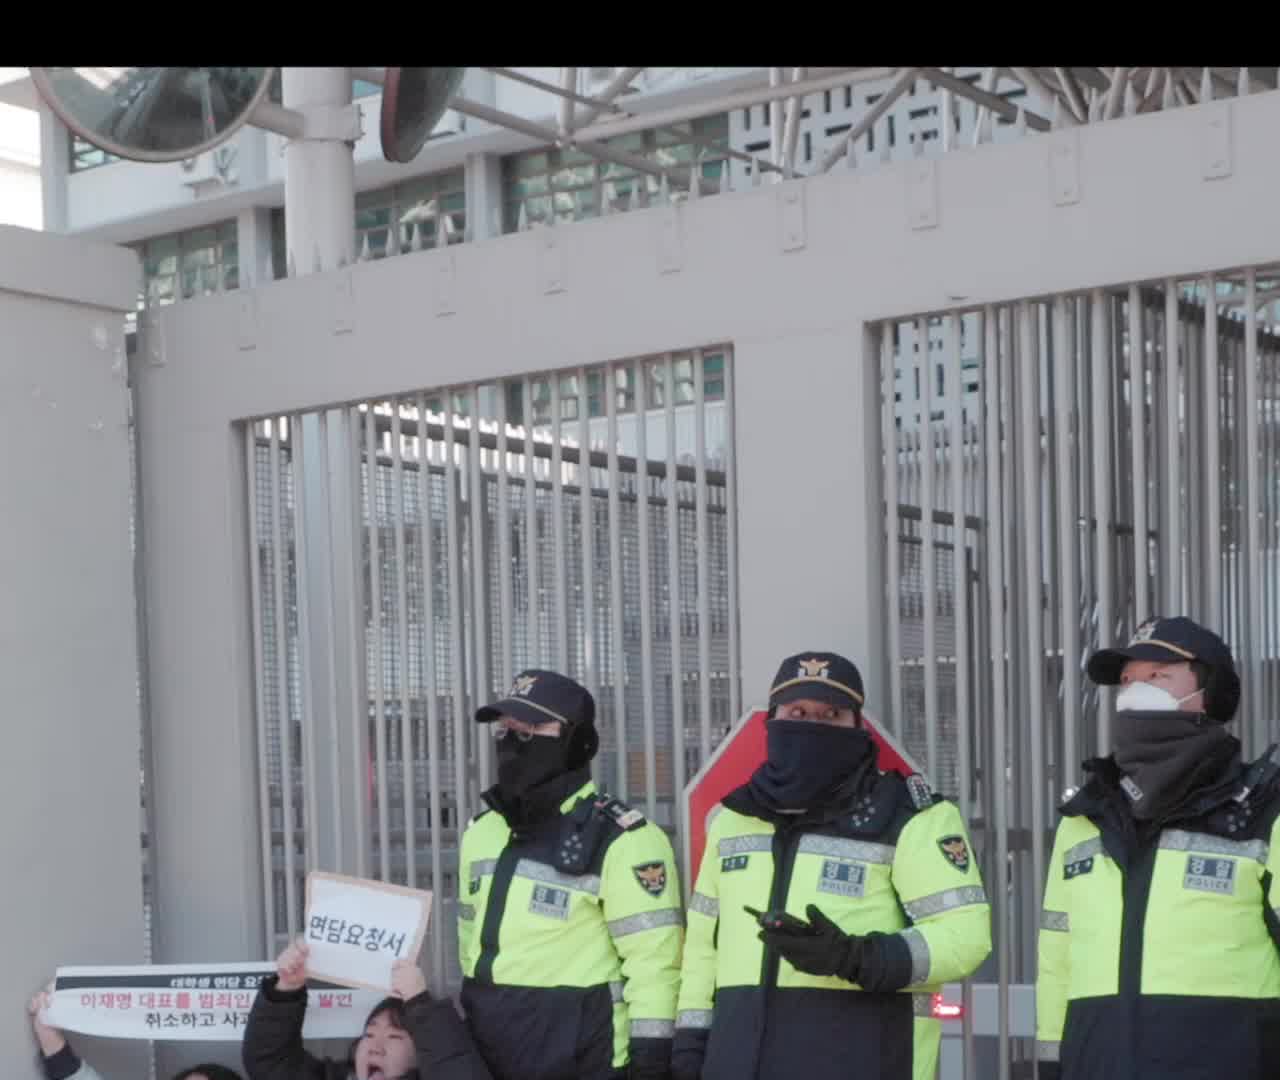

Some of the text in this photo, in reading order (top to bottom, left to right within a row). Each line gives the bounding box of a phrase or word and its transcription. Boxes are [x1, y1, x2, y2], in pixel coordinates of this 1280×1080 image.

[310, 915, 408, 958] 면담요청서
[80, 991, 251, 1009] 이재명 대표를 범죄인
[318, 992, 353, 1009] 발언
[145, 1011, 217, 1029] 취소하고
